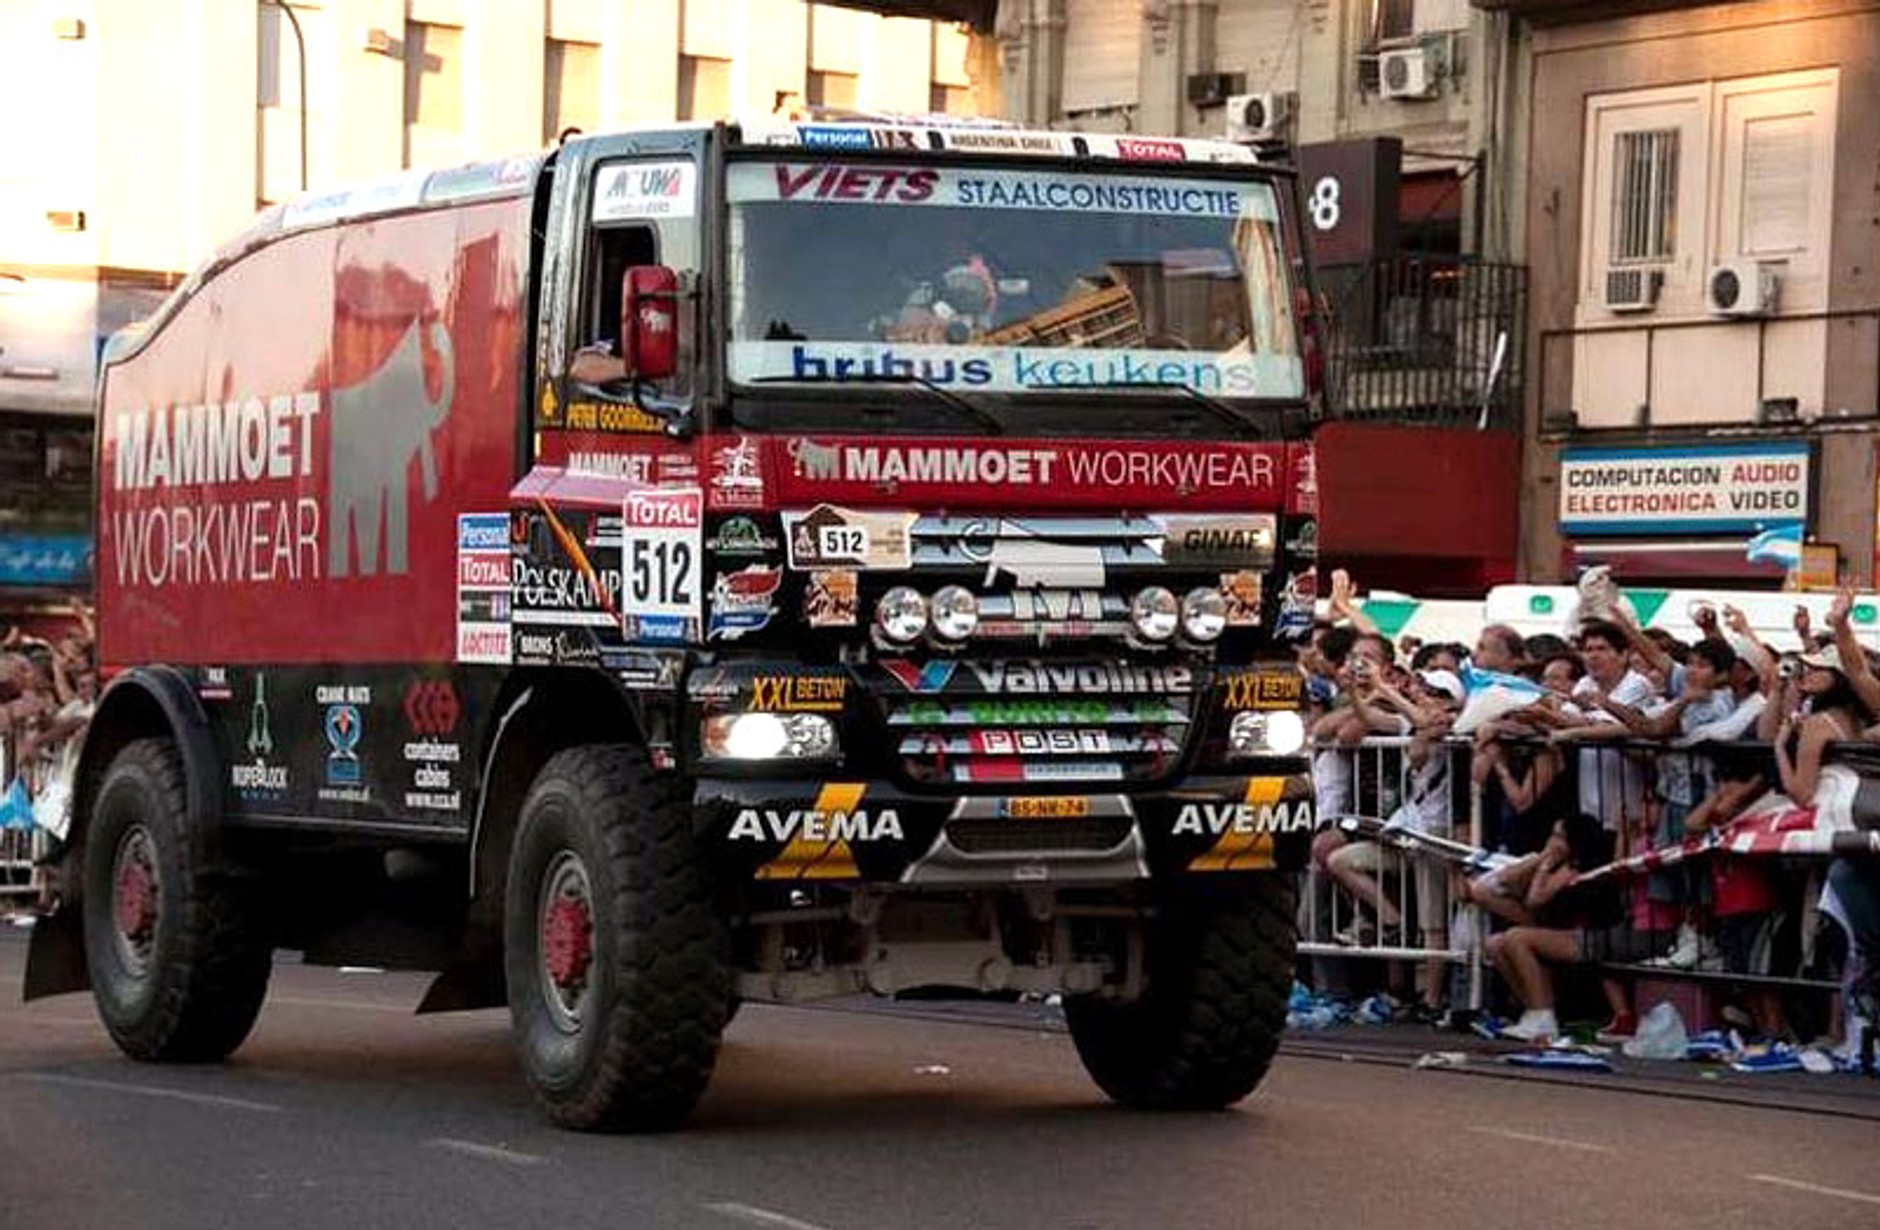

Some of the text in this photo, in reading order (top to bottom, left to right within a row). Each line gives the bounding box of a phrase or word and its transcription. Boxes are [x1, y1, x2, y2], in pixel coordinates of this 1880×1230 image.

[805, 130, 868, 145] Personal
[1122, 141, 1183, 159] TOTAL
[774, 164, 1239, 213] VIETS STAALCONSTRUCTIE
[1016, 351, 1255, 389] keukens
[115, 391, 319, 490] MAMMOET
[567, 451, 652, 483] MAMMOET
[845, 447, 1273, 486] MAMMOET WORKWEAR
[1568, 463, 1799, 488] COMPUTACION AUDIO
[629, 496, 697, 524] TOTAL
[1568, 490, 1799, 513] ELECTRONICA VIDEO
[114, 498, 319, 586] WORKWEAR
[826, 530, 863, 552] 512
[461, 557, 509, 583] TOTAL
[632, 538, 691, 605] 512
[962, 659, 1193, 693] Valvoline
[747, 676, 793, 711] XXL
[797, 677, 845, 699] BETON
[984, 731, 1111, 753] POST
[728, 810, 904, 841] AVEMA
[1172, 801, 1312, 836] AVEMA
